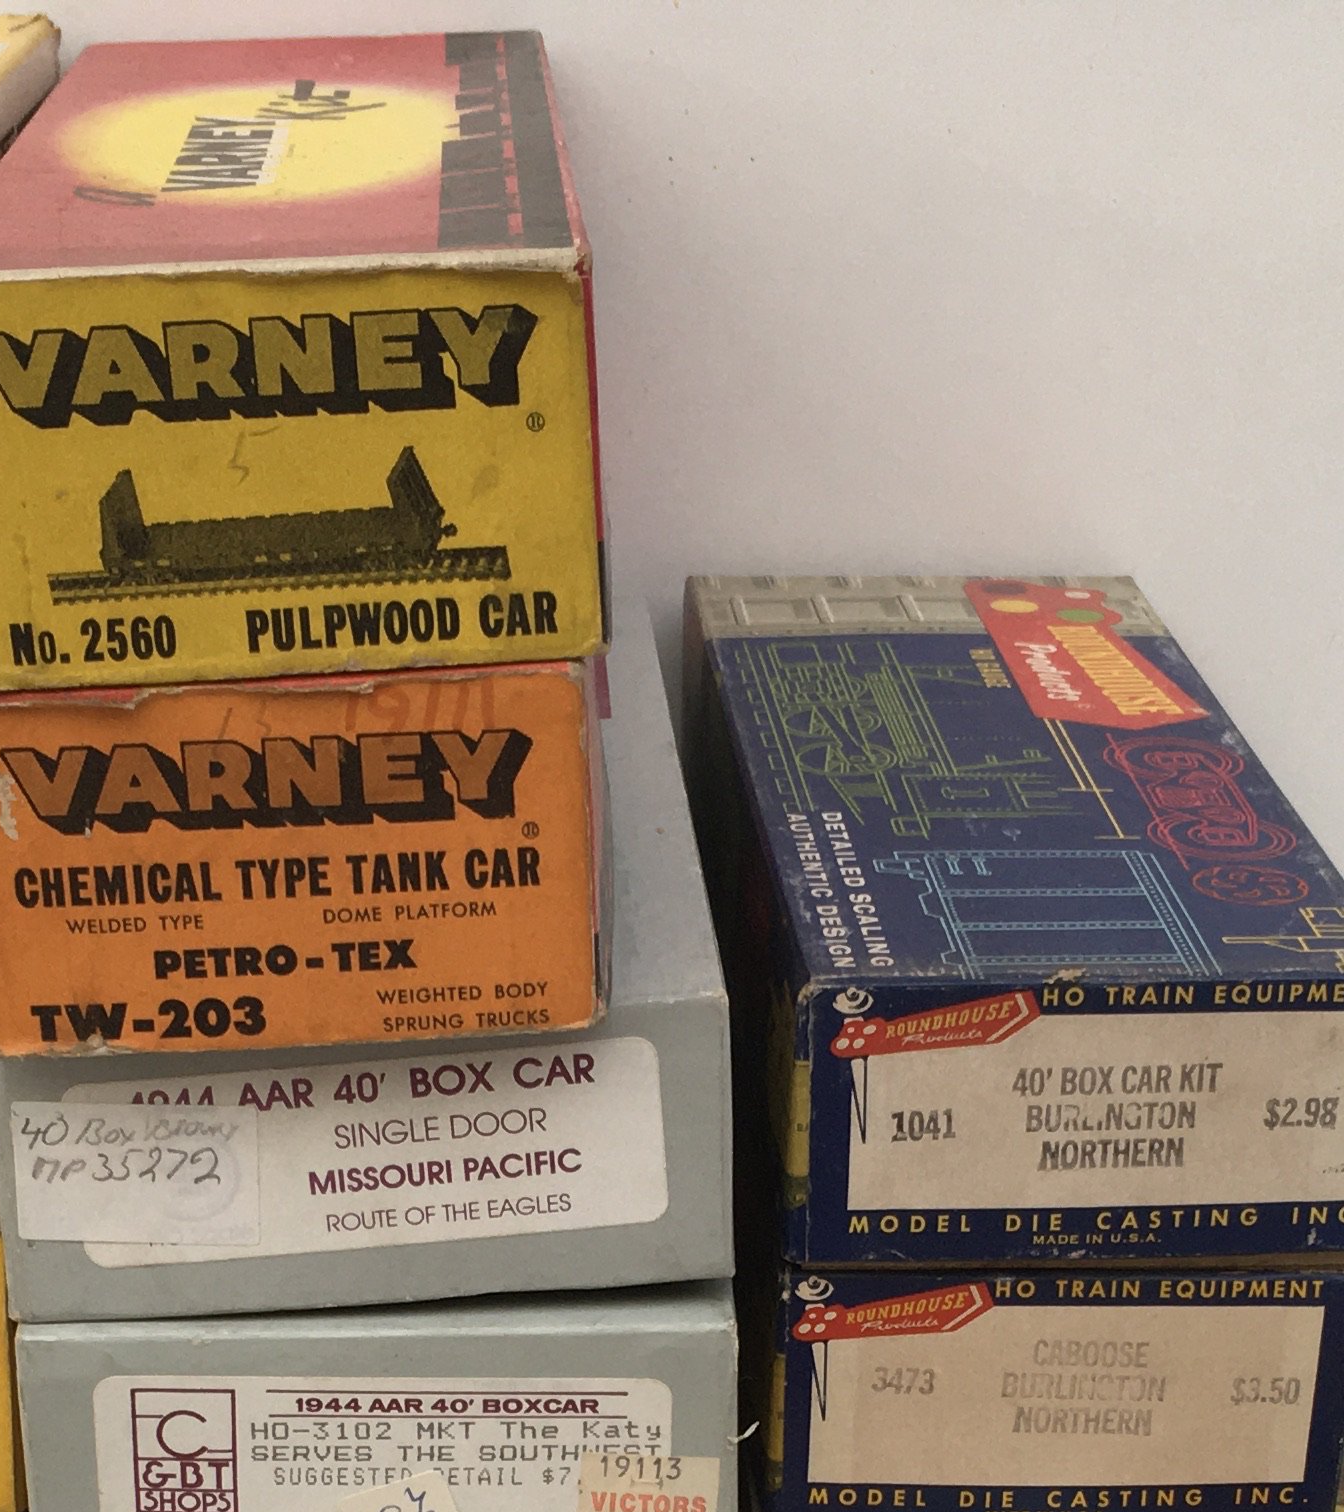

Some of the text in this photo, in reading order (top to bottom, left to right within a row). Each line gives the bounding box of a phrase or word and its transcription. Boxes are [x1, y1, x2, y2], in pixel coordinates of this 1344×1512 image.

[160, 116, 277, 193] VARNEY
[10, 591, 558, 666] No. 2560 PULPWOOD CAR
[0, 729, 534, 836] VARNEY
[15, 848, 542, 909] CHEMICAL TYPE TANK CAR
[786, 813, 856, 968] AUTHENTIC DESIGN
[821, 812, 894, 967] DETAILED SCALING
[66, 914, 204, 935] WELDED TYPE
[324, 901, 497, 925] DOME PLATFORM
[377, 981, 548, 1005] WEIGHTED BODY
[1042, 987, 1086, 1007] HO
[1106, 985, 1194, 1005] TRAIN
[30, 996, 267, 1043] TW-203
[383, 1008, 550, 1032] SPRUNG TRUCKS
[886, 1000, 1015, 1039] ROUNDHOUSE
[238, 1052, 596, 1110] AAR BOX CAR
[1012, 1061, 1223, 1096] 40' BOX CAR KIT
[332, 1107, 548, 1150] SINGLE DOOR
[891, 1107, 956, 1143] 1041
[1026, 1101, 1196, 1133] BURLINGTON
[1263, 1097, 1338, 1131] $2.98
[1037, 1137, 1184, 1172] NORTHERN
[308, 1147, 583, 1197] MISSOURI PACIFIC
[325, 1193, 573, 1233] ROUTE OF THE EAGLES
[848, 1214, 971, 1234] MODEL
[1004, 1213, 1062, 1233] DIE
[1097, 1208, 1258, 1232] CASTING
[1033, 1234, 1105, 1246] MADE IN
[995, 1279, 1325, 1301] HO TRAIN EQUIPMENT
[845, 1292, 969, 1325] ROUNDHOUSE
[1033, 1340, 1151, 1368] CABOOSE
[870, 1367, 935, 1395] 3473
[1000, 1370, 1167, 1403] BURLINGTON
[1230, 1375, 1301, 1406] $3.50
[295, 1397, 600, 1415] 1944 AAR 40' BOXCAR
[1012, 1406, 1153, 1437] NORTHERN
[250, 1419, 662, 1442] HO-3102 MKT The Katy
[250, 1444, 457, 1463] SERVES THE
[600, 1455, 682, 1480] 19113
[809, 1485, 1309, 1509] MODEL DIE CASTING INC.
